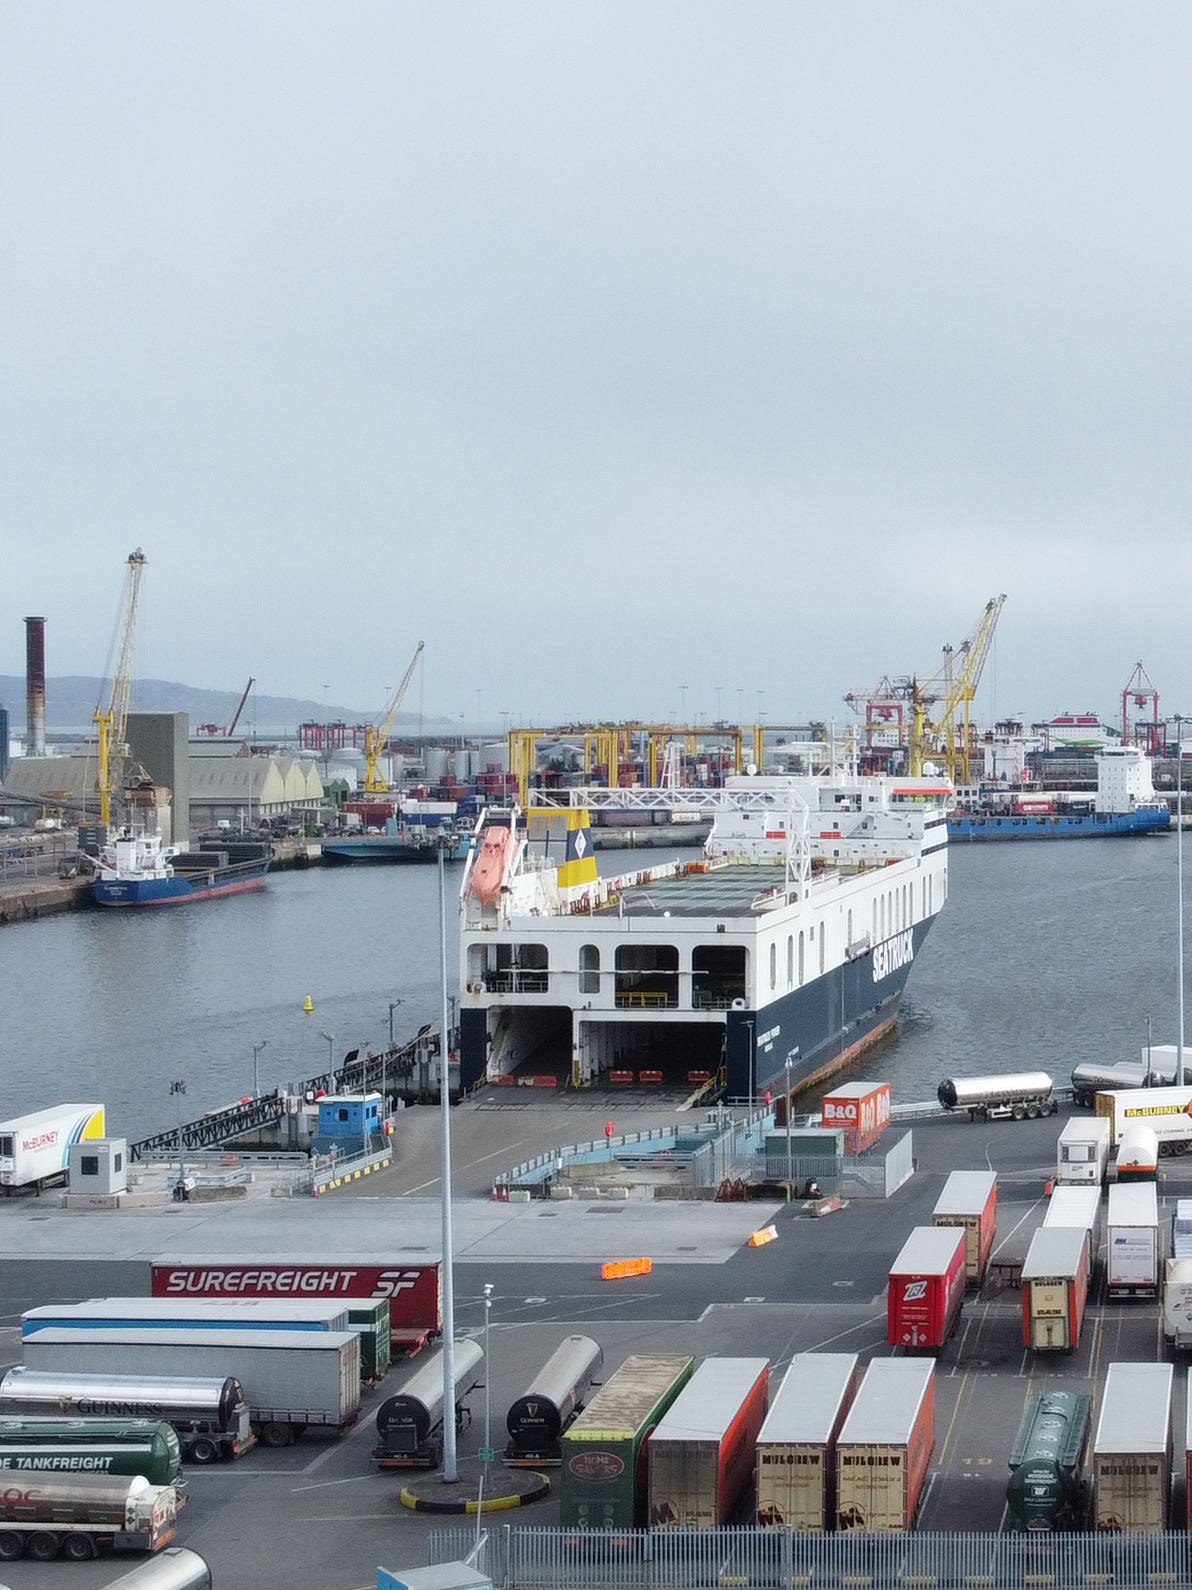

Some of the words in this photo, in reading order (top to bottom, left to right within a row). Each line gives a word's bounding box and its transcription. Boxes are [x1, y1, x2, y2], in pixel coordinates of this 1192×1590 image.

[824, 1104, 857, 1119] B&Q
[1126, 1105, 1186, 1117] McBURNEY
[167, 1271, 357, 1291] SUREFREIGHT
[77, 1398, 163, 1415] GUINNESS
[16, 1457, 113, 1469] TANKFREIGHT
[762, 1455, 820, 1465] MULGREW
[843, 1456, 901, 1466] MULGREW
